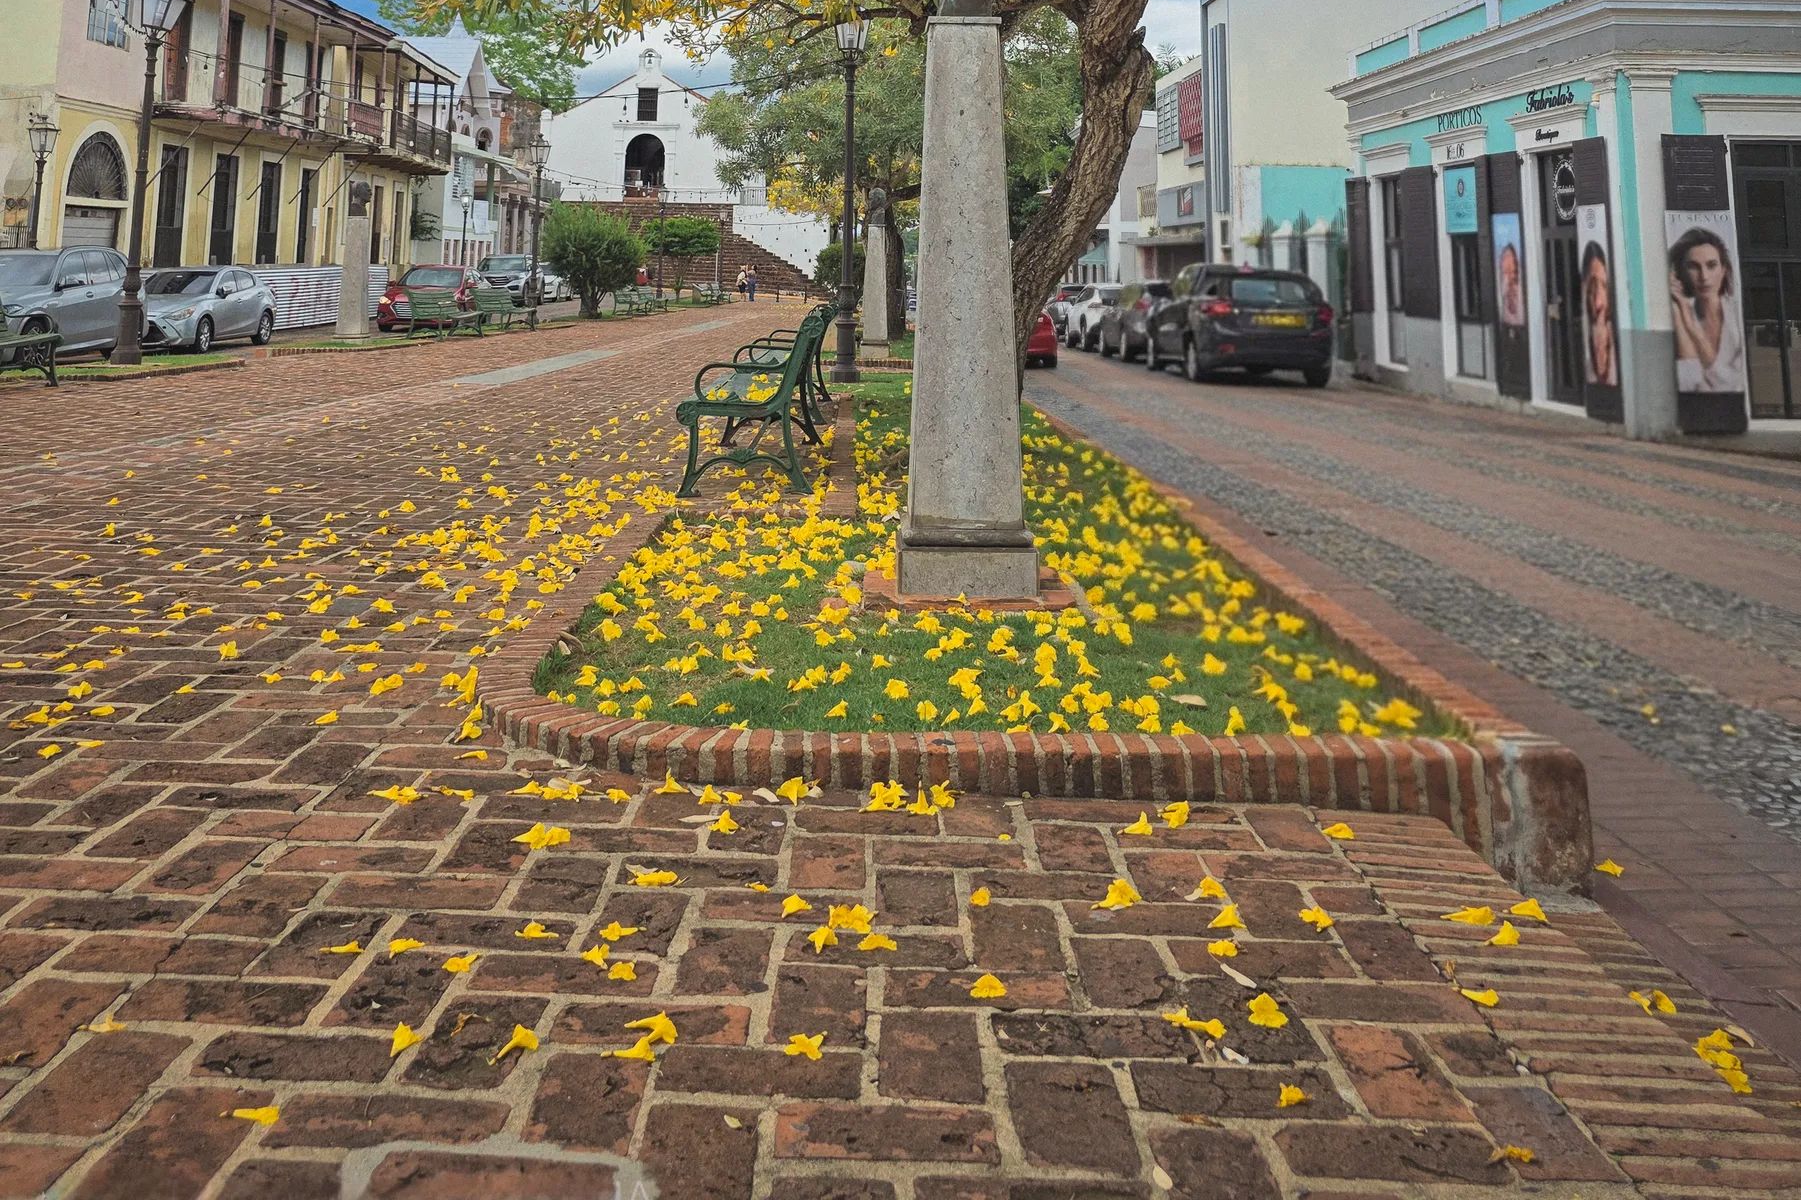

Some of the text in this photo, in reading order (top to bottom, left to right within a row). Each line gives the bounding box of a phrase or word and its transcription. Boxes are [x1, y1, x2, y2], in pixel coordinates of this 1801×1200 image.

[1526, 85, 1574, 113] Fabriola's
[1437, 105, 1482, 132] PORTICOS
[1535, 129, 1559, 143] Boutique
